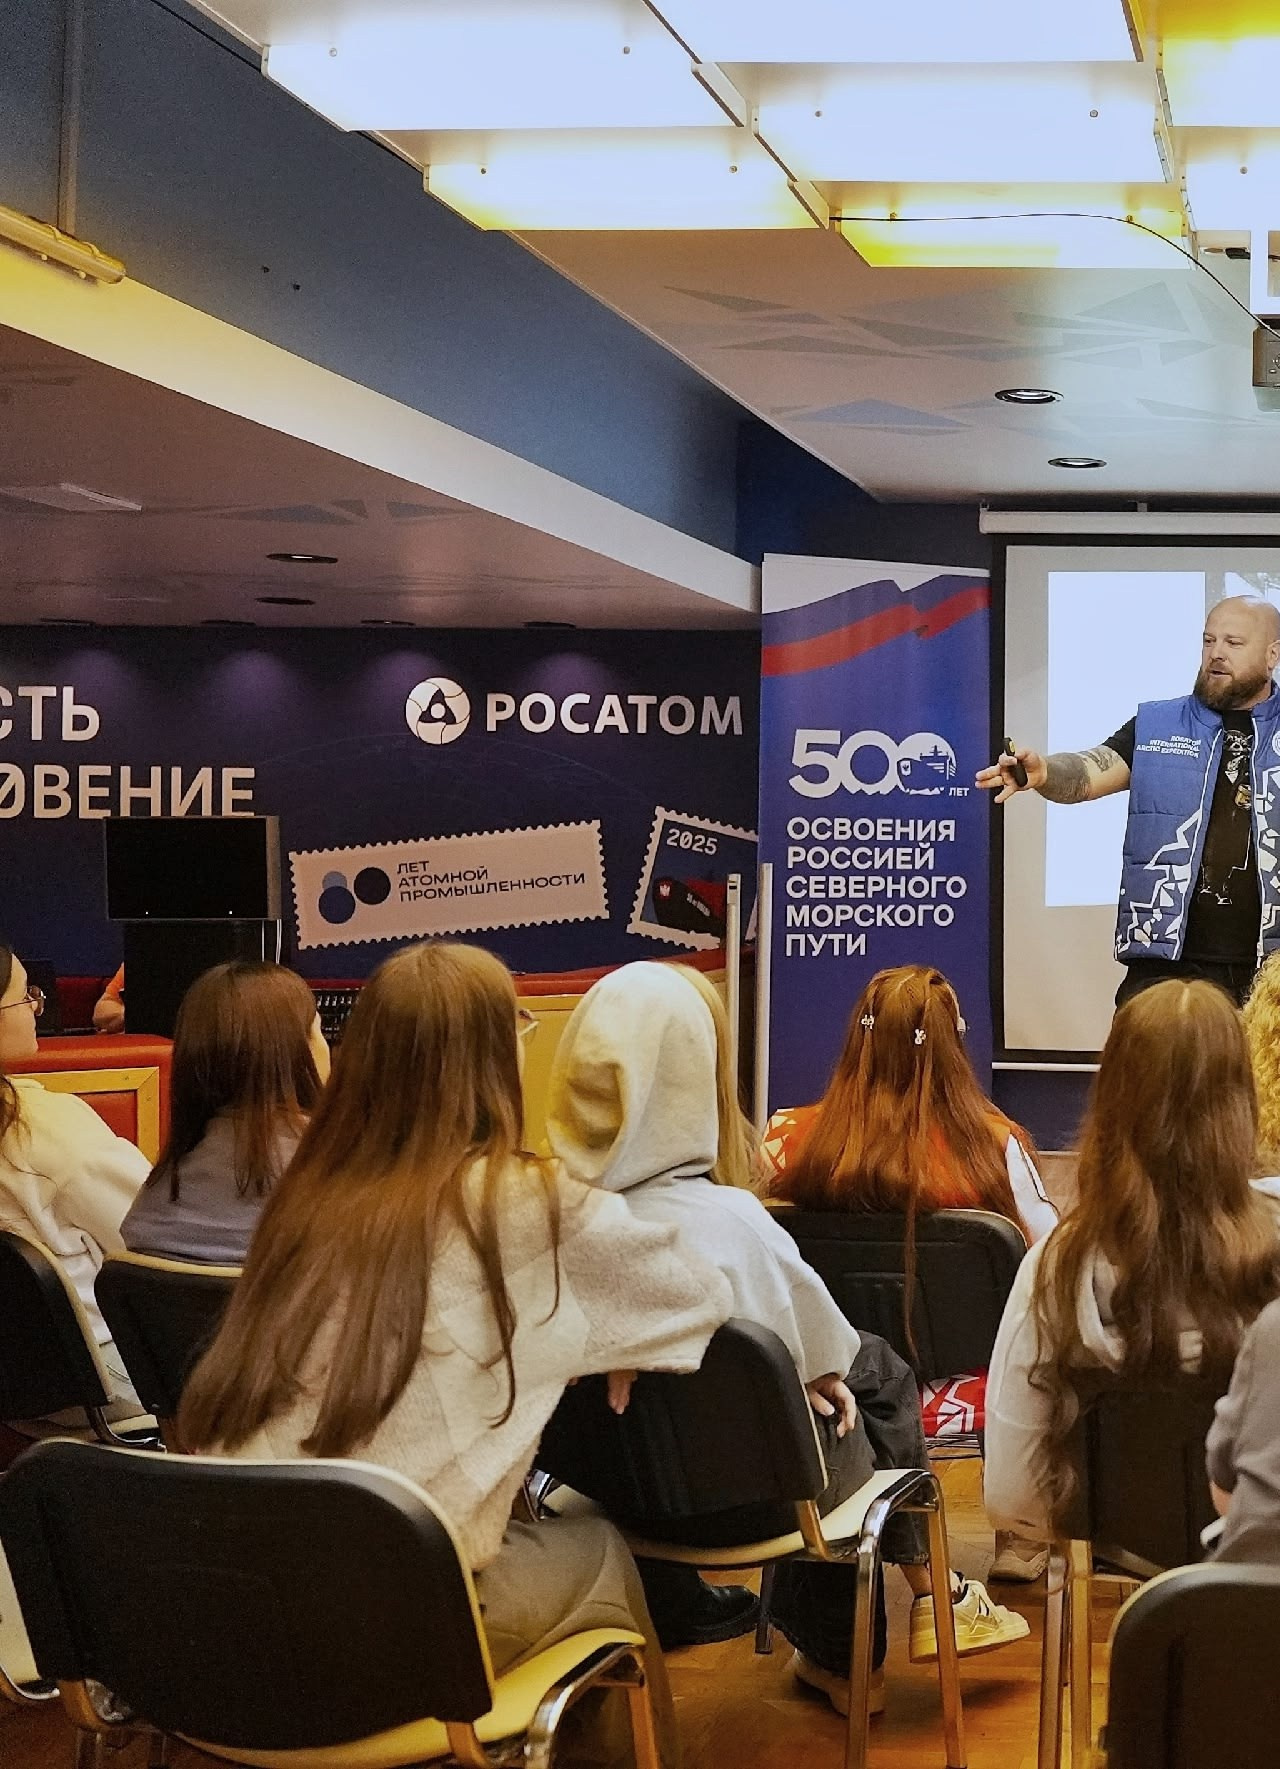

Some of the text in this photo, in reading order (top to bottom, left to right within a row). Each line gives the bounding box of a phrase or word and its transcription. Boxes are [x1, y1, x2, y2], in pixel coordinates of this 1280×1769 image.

[486, 692, 743, 736] РОСАТОМ
[788, 728, 970, 799] 500 ЛЕТ
[787, 817, 956, 841] ОСВОЕНИЯ
[666, 828, 718, 855] 2025
[397, 861, 430, 874] ЛЕТ
[787, 842, 935, 870] РОССИЕЙ
[398, 866, 488, 889] АТОМНОЙ
[400, 872, 585, 902] ПРОМЫШЛЕННОСТИ
[786, 875, 968, 899] СЕВЕРНОГО
[786, 904, 955, 927] МОРСКОГО
[786, 933, 866, 956] ПУТИ
